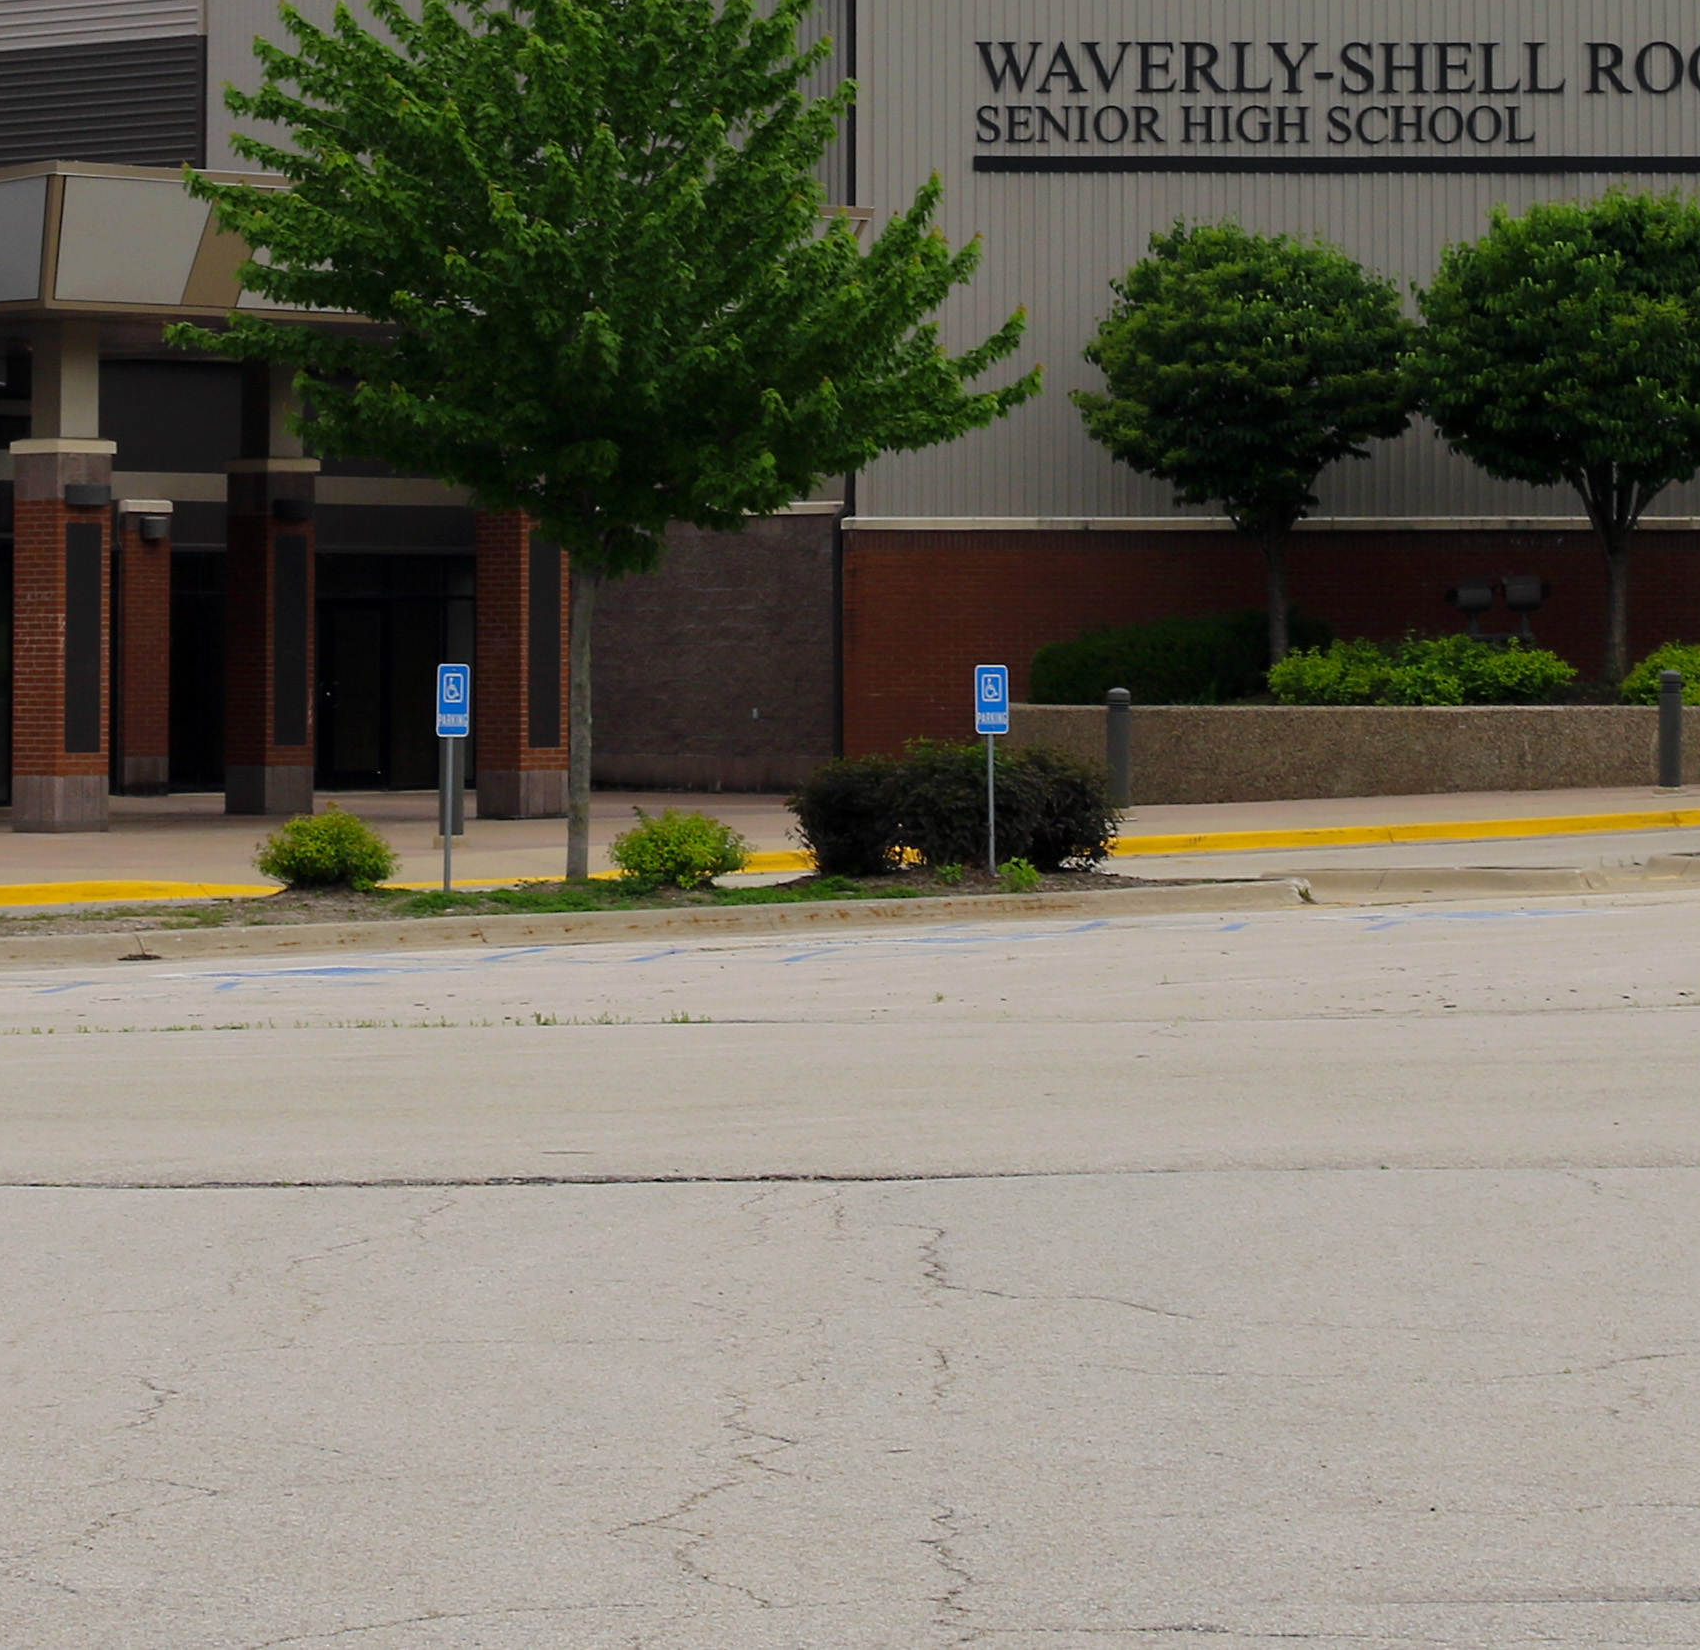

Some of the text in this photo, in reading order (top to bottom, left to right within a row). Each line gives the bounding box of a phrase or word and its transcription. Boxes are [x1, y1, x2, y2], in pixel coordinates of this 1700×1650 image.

[974, 41, 1566, 95] WAVERLY-SHELL
[976, 104, 1536, 145] SENIOR HIGH SCHOOL
[438, 713, 469, 727] PARKING
[977, 712, 1008, 725] PARKING
